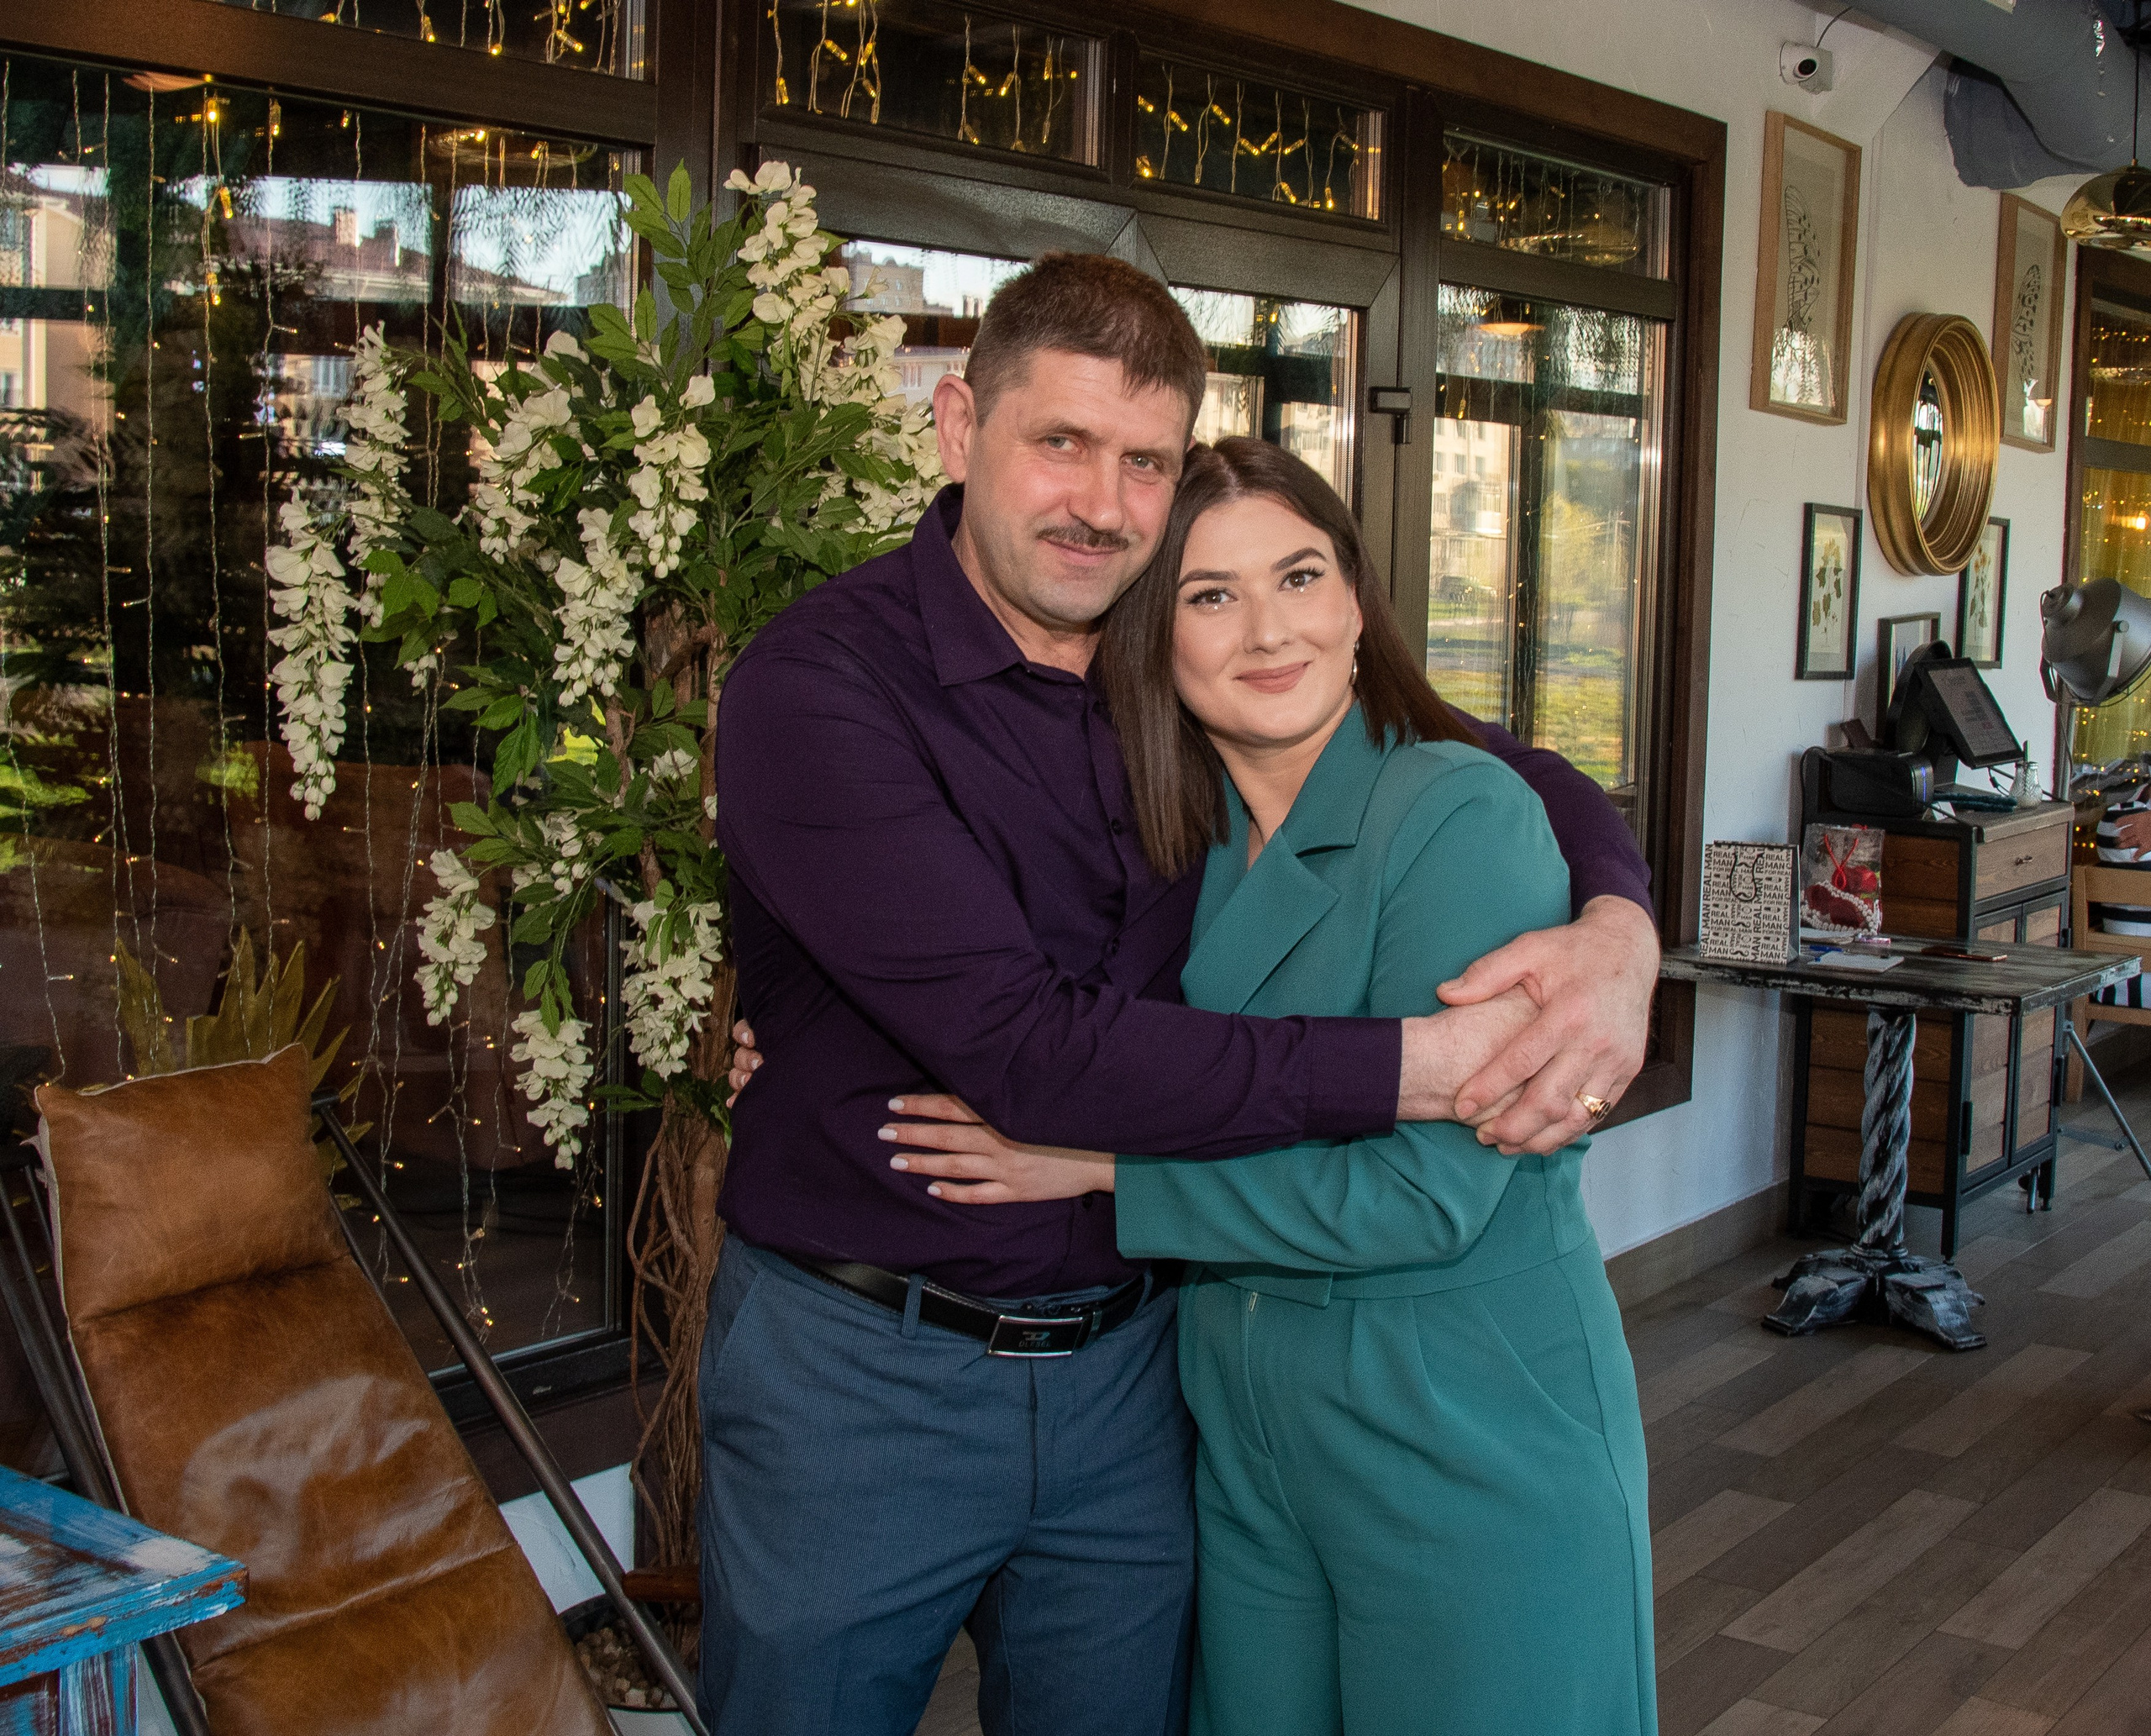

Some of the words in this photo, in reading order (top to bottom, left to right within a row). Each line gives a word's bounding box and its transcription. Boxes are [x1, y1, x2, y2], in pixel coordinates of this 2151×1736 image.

[1703, 871, 1712, 902] REAL
[1764, 892, 1783, 900] MAN
[1753, 905, 1762, 933] REAL
[1700, 930, 1710, 958] REAL
[1751, 936, 1761, 963] MAN
